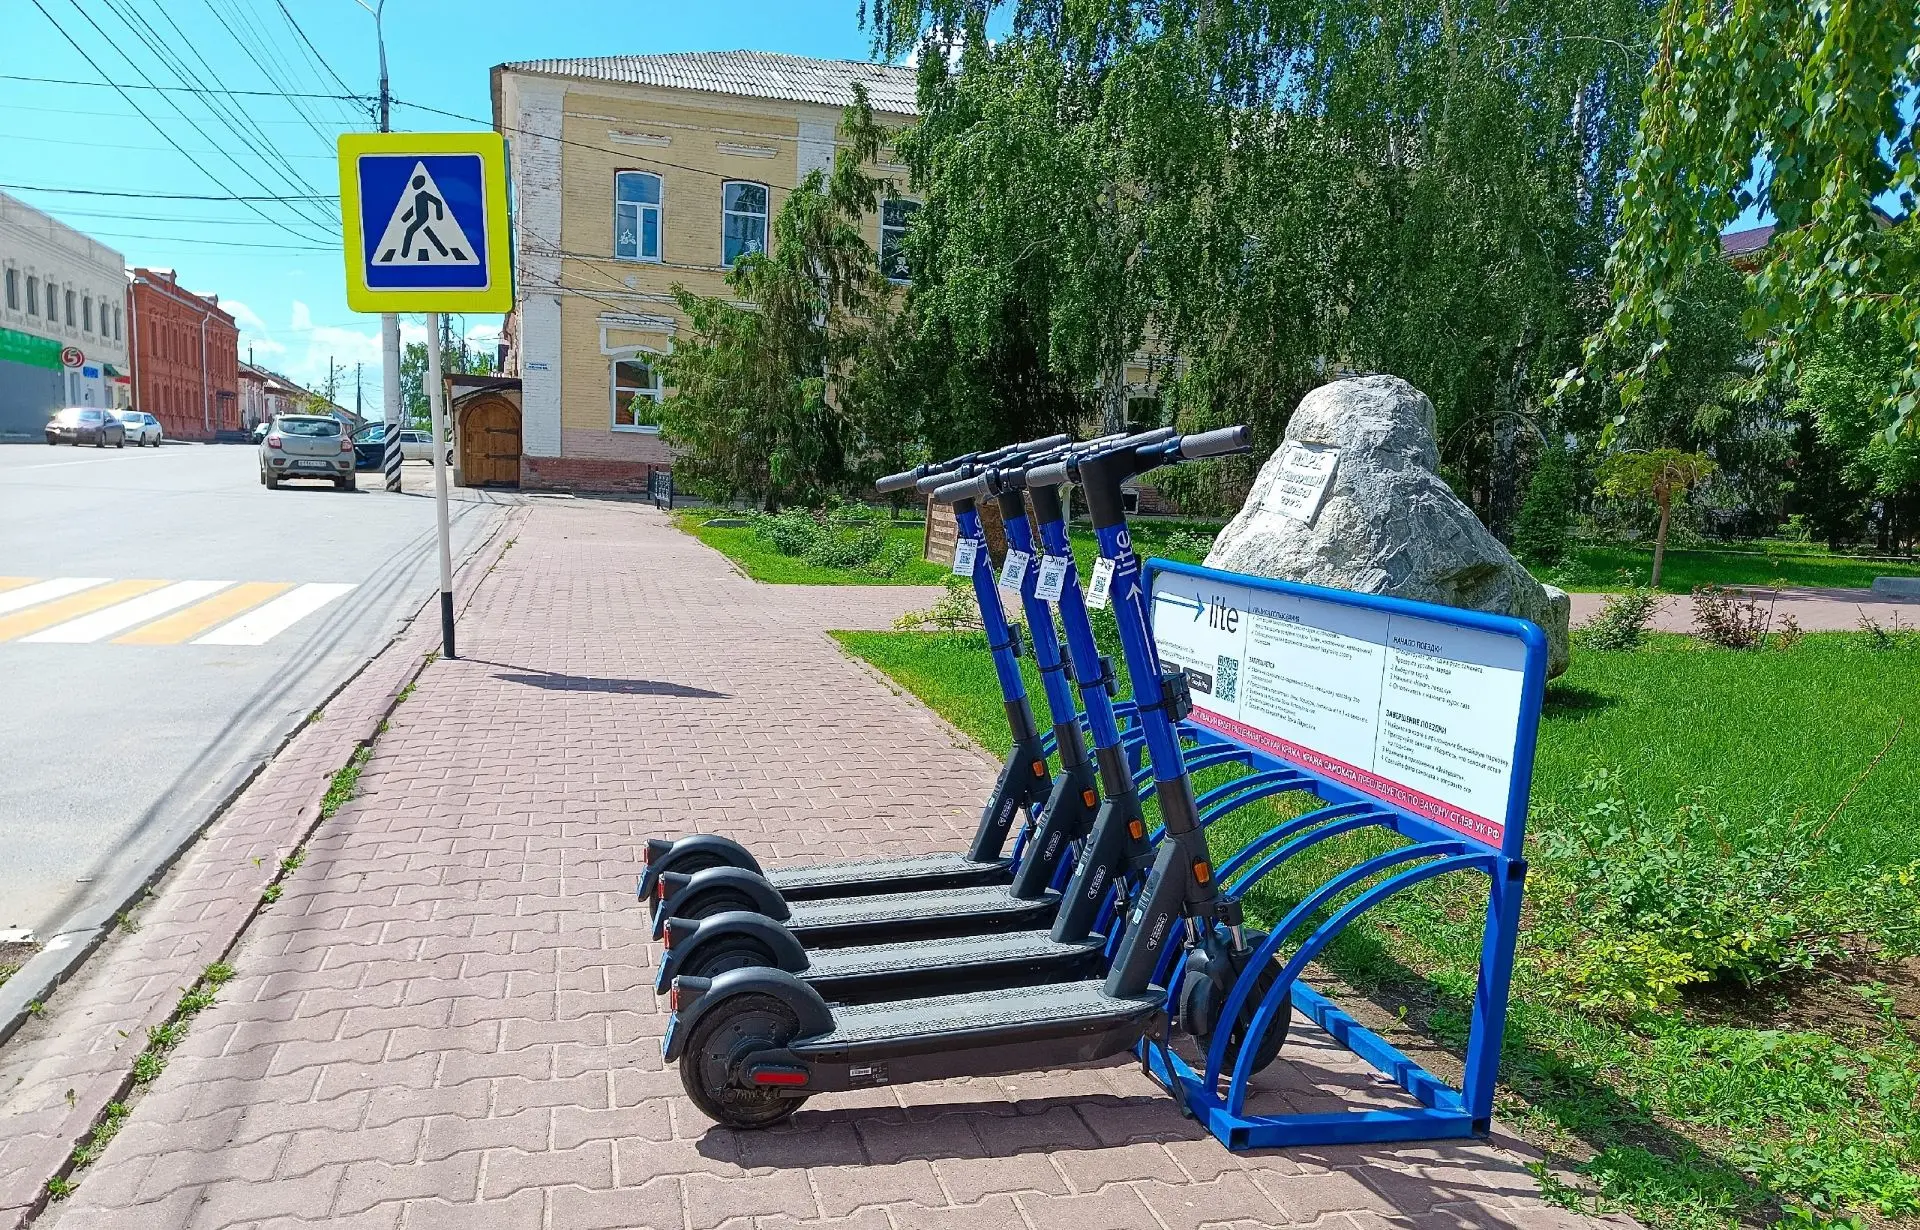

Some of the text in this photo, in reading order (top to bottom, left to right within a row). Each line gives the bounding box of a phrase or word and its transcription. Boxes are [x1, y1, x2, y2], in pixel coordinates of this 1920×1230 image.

[1114, 530, 1138, 577] lite
[1209, 595, 1239, 633] lite
[1393, 636, 1443, 654] НАЧАЛО ПОЕЗДКИ
[1386, 709, 1420, 727] ЗАВЕРШЕНИЕ
[1420, 719, 1447, 735] ПОЕЗДКИ
[1323, 760, 1358, 781] САМОКАТА
[1357, 772, 1406, 801] ПРЕСЛЕДУЕТСЯ
[1407, 793, 1419, 806] ПО
[1419, 796, 1450, 818] ЗАКОНУ
[1474, 820, 1487, 836] УК
[1487, 825, 1500, 841] РФ
